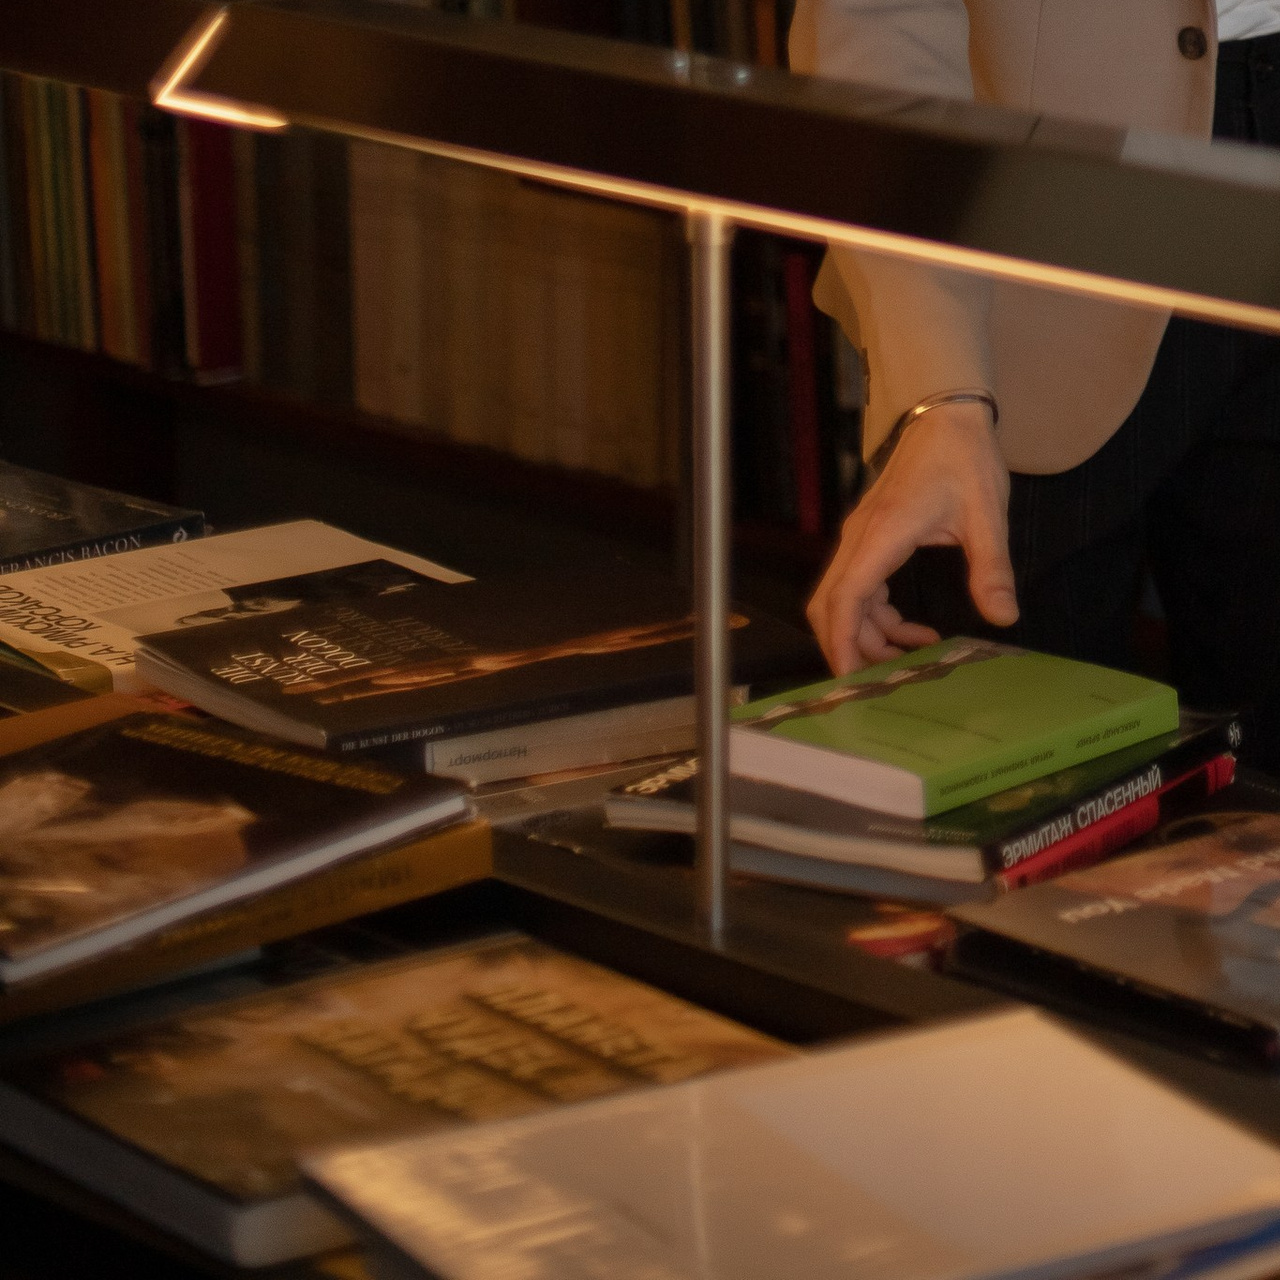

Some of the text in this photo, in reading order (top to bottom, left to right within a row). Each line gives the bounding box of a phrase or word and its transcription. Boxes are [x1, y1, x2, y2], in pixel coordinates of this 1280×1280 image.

[0, 534, 142, 574] FRANCIS BACON
[281, 630, 373, 669] DOGON
[282, 651, 340, 676] DER
[210, 665, 264, 685] DIE
[230, 651, 315, 686] KUNST
[1002, 811, 1074, 869] ЭРМИТАЖ
[1077, 764, 1163, 831] СПАСЕННЫЙ
